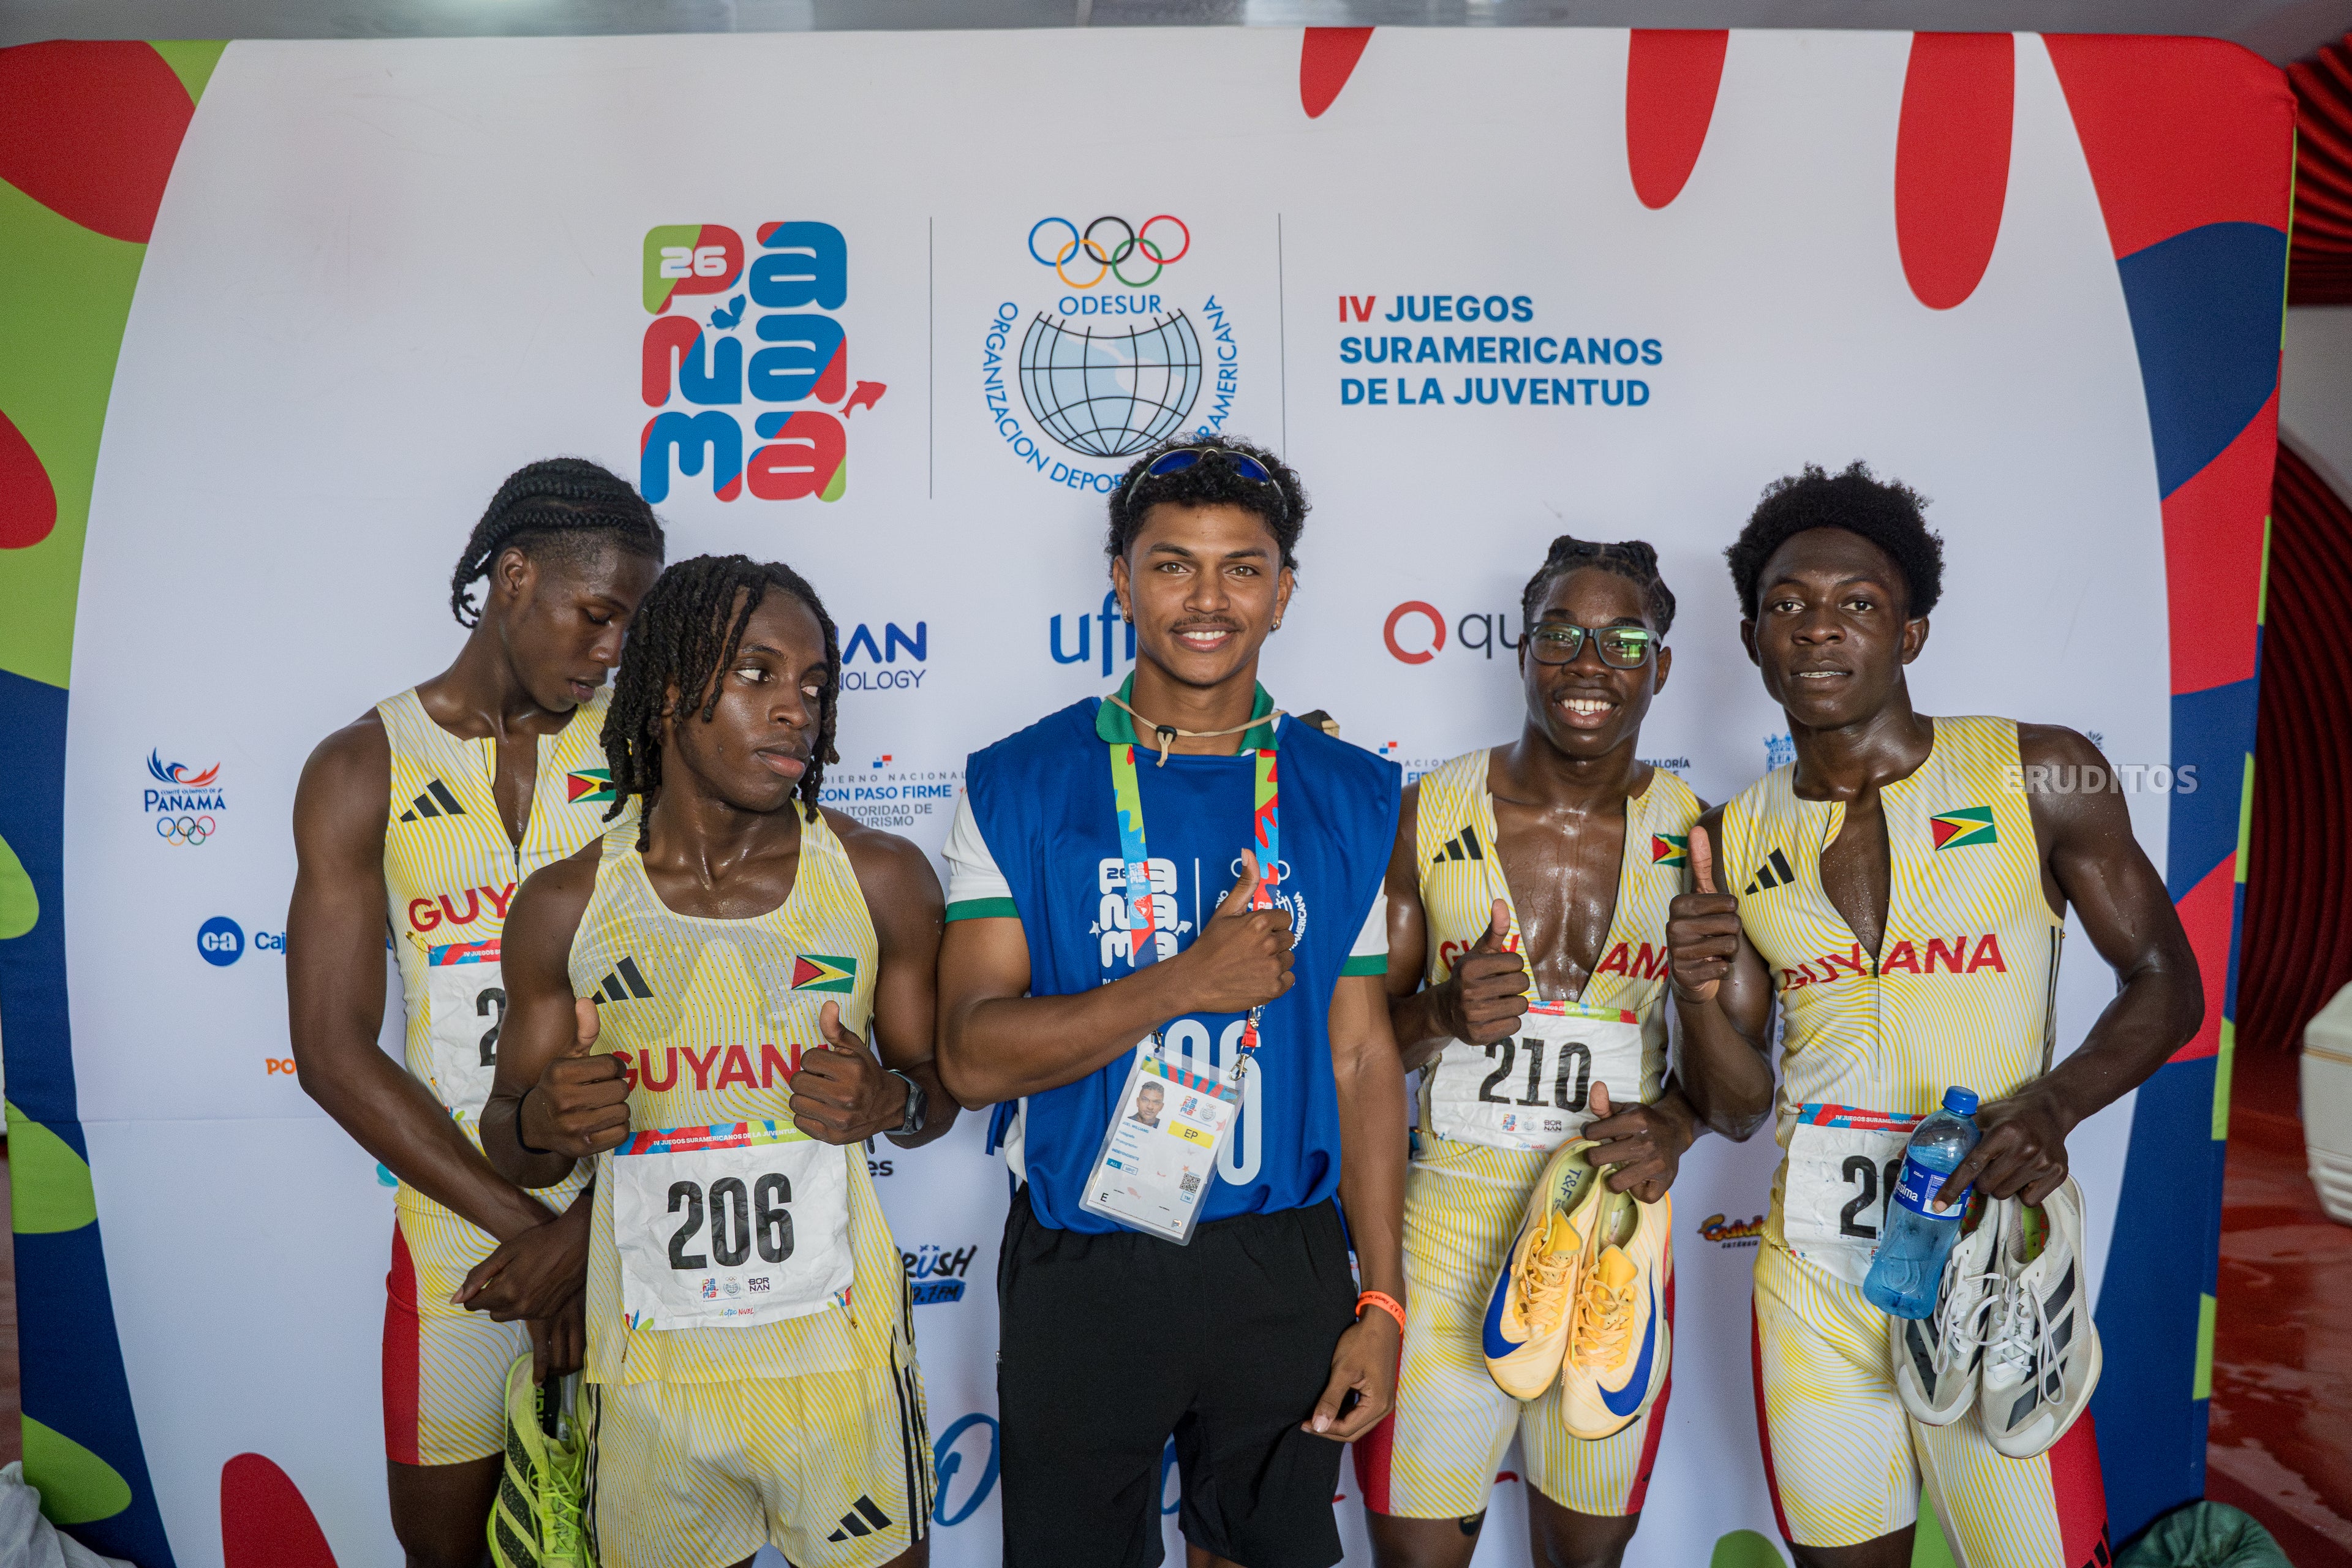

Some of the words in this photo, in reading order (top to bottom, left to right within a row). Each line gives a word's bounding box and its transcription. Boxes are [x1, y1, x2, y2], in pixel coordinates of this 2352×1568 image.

[1058, 295, 1162, 315] ODESUR
[1338, 296, 1376, 322] IV
[1385, 296, 1533, 322] JUEGOS
[1340, 337, 1662, 365] SURAMERICANOS
[983, 302, 1050, 473] ORGANIZACION
[1192, 295, 1237, 443] RAMERICANA
[1341, 378, 1387, 405] DE
[1398, 378, 1445, 405] LA
[1453, 378, 1649, 406] JUVENTUD
[835, 621, 927, 665] AN
[1458, 613, 1518, 660] qu
[144, 788, 227, 812] PANAMÁ
[856, 786, 898, 801] PASO
[903, 785, 952, 799] FIRME
[833, 804, 910, 817] UTORIDAD
[914, 804, 932, 814] DE
[409, 882, 518, 932] GUY
[255, 932, 286, 956] Caj
[1779, 933, 2008, 993] GUYANA
[266, 1058, 296, 1075] PO
[612, 1043, 829, 1095] GUYAN
[1479, 1037, 1591, 1112] 210
[687, 1134, 742, 1144] SURAMERICANOS
[763, 1128, 797, 1137] JUVENTUD
[1184, 1128, 1198, 1139] EP
[1101, 1193, 1109, 1202] E
[1561, 1169, 1582, 1199] T&F
[667, 1172, 795, 1270] 206
